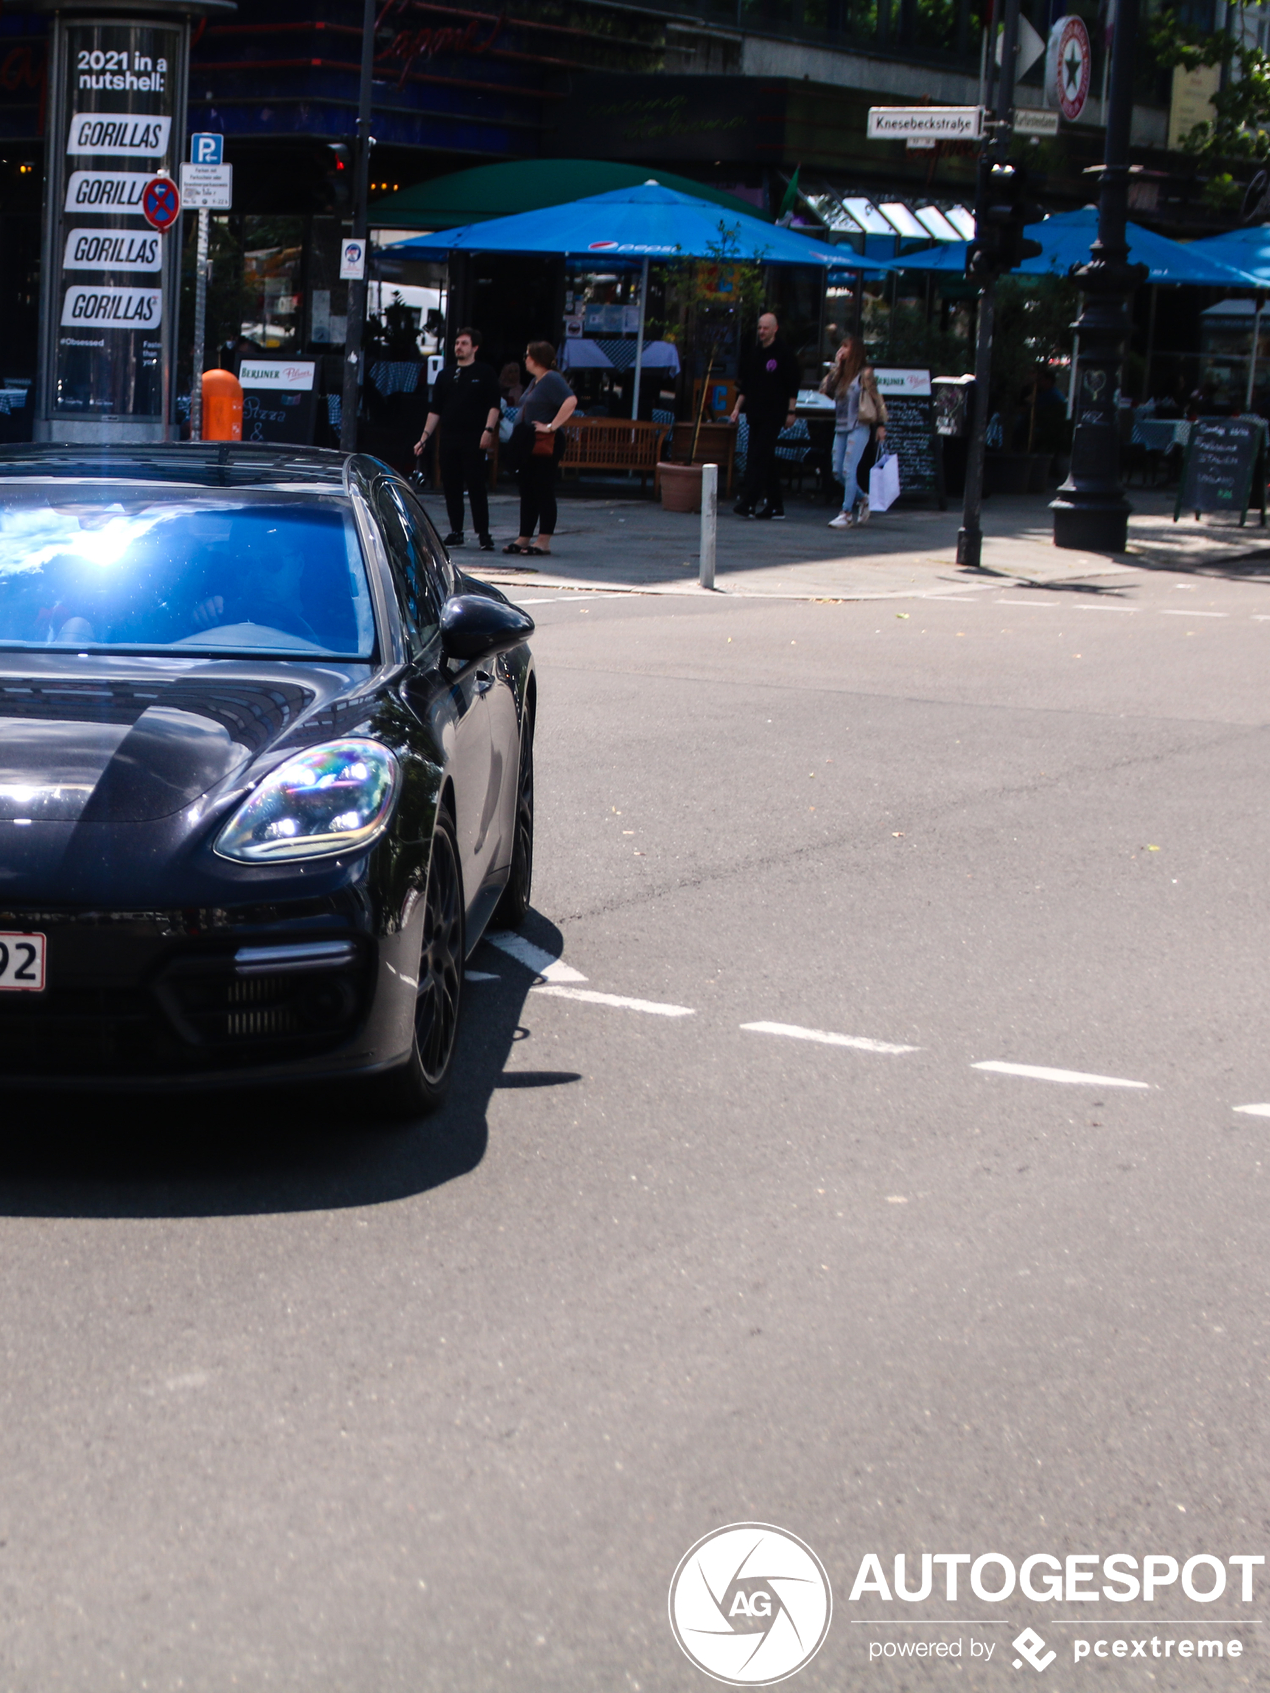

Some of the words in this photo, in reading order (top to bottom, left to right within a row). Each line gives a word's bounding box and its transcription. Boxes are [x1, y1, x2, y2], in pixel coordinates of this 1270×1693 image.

[77, 50, 128, 70] 2021
[134, 51, 152, 71] in
[156, 58, 167, 72] a
[79, 71, 165, 92] nutshell:
[78, 121, 162, 149] GORILLAS
[876, 116, 972, 136] Knesebeckstraße
[198, 137, 216, 162] P
[75, 179, 144, 205] GORILLA
[74, 236, 159, 264] GORILLAS
[72, 294, 154, 321] GORILLAS
[60, 337, 104, 347] #Obsessed
[243, 396, 287, 422] Pizza
